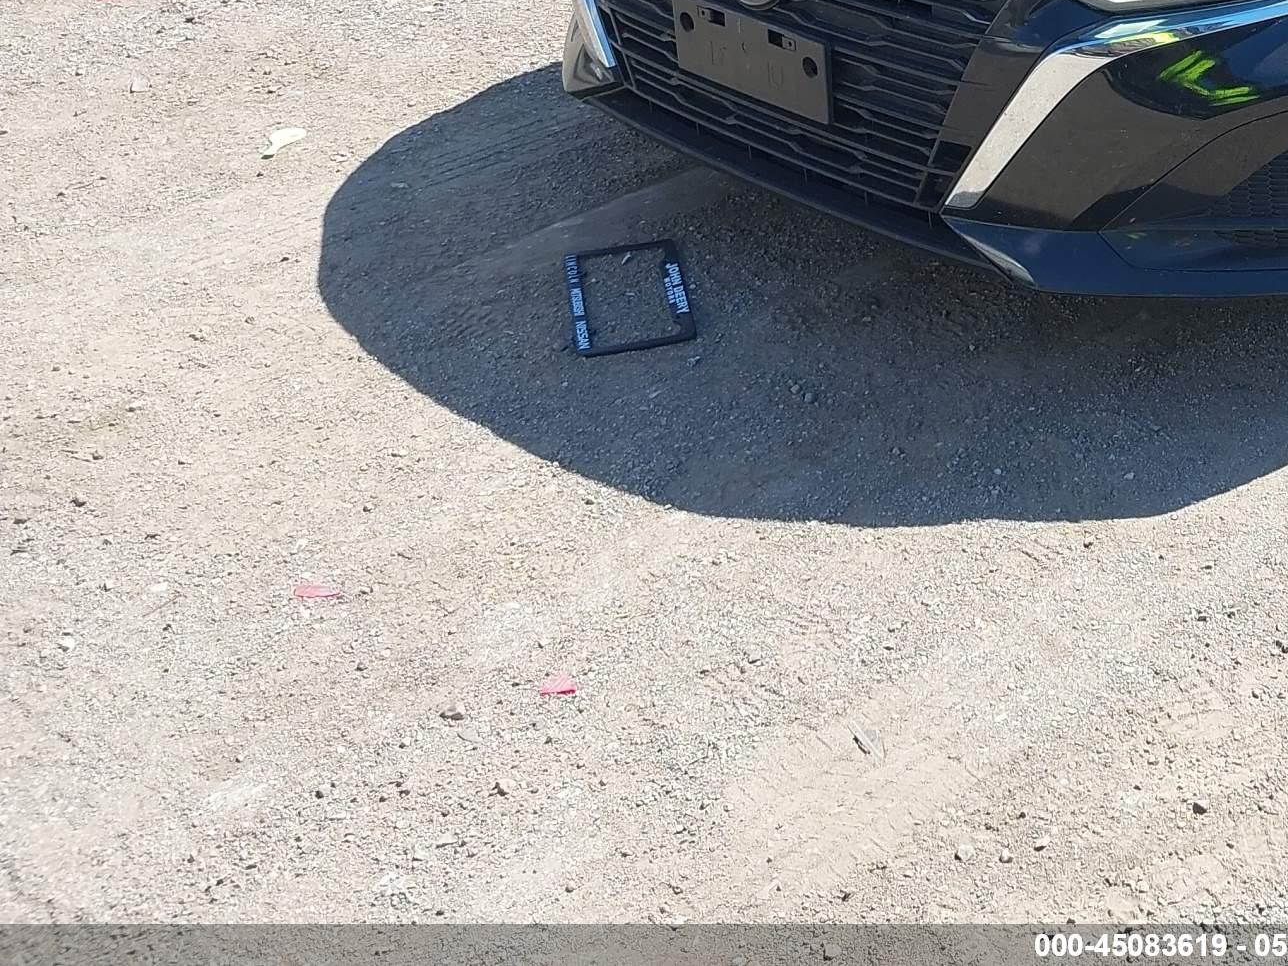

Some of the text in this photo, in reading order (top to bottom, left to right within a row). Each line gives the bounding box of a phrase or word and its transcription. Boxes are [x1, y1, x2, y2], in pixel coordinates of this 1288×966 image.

[666, 263, 690, 313] JOHN DEERY
[576, 321, 590, 349] NISSAN
